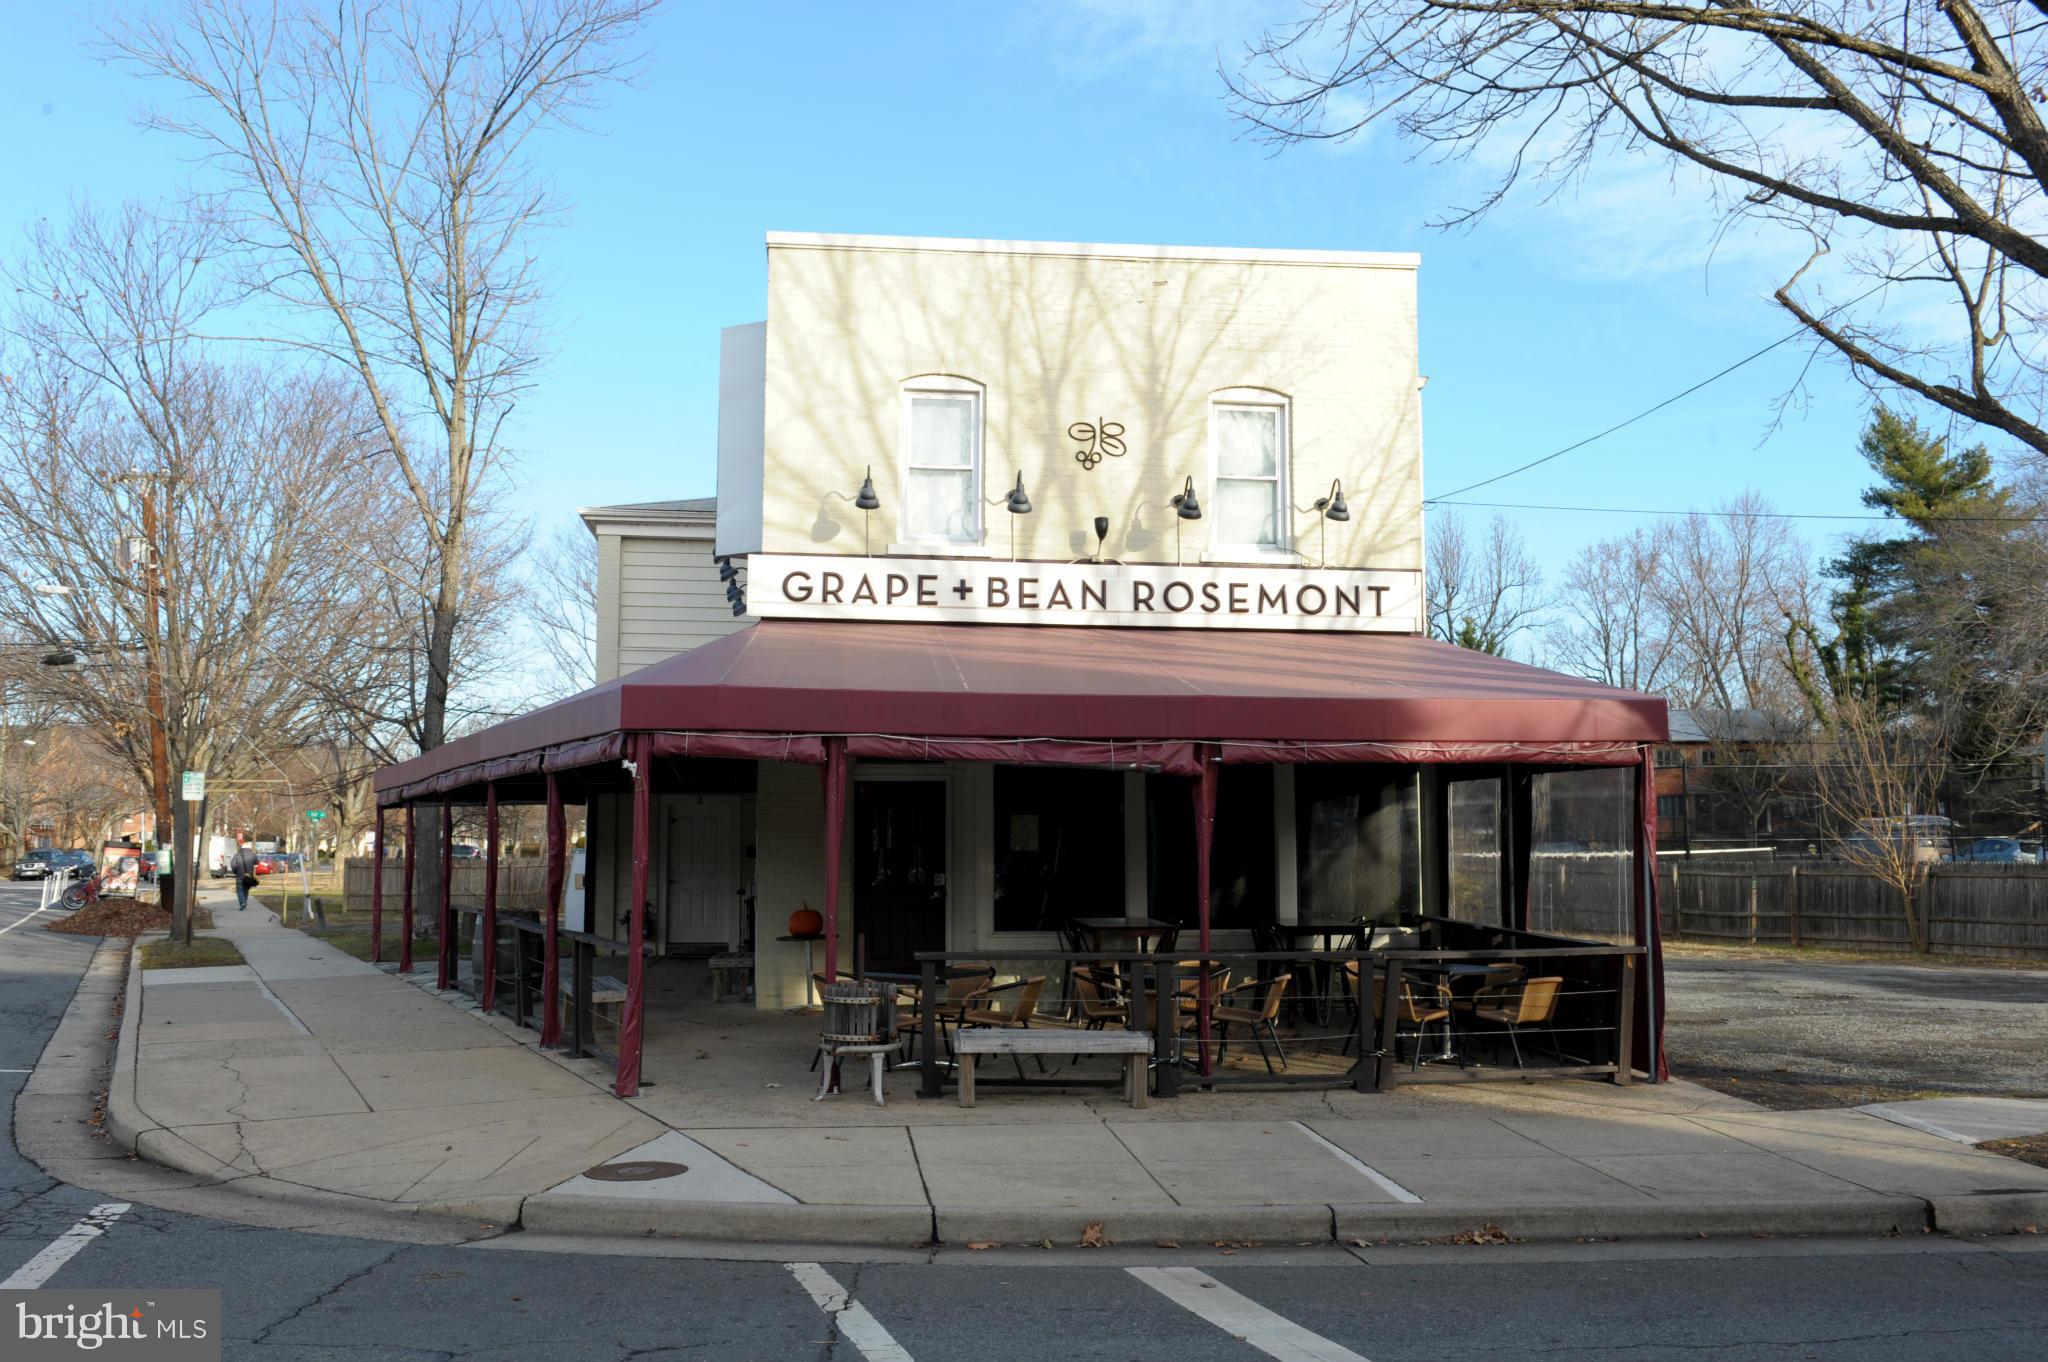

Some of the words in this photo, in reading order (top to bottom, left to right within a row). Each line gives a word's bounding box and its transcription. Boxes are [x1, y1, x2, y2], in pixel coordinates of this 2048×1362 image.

[782, 571, 938, 606] GRAPE
[987, 577, 1107, 610] BEAN
[1133, 581, 1390, 617] ROSEMONT
